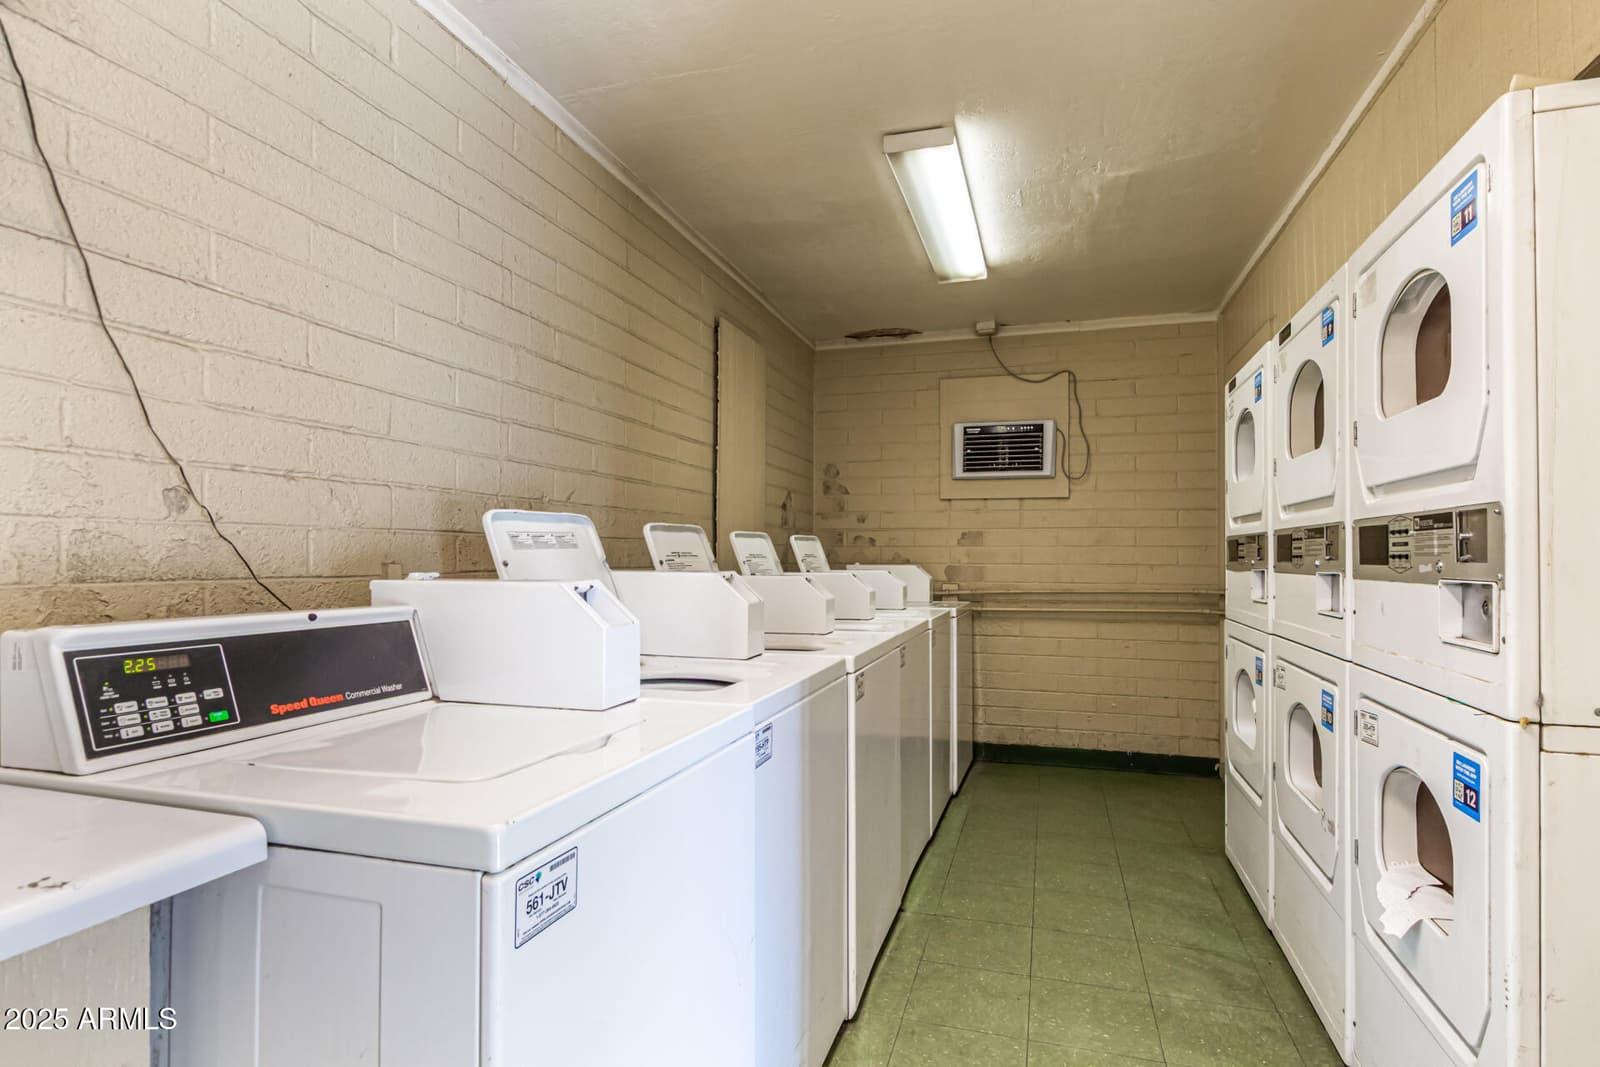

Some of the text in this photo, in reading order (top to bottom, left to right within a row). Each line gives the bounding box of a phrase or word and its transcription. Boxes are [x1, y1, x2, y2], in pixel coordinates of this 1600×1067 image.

[123, 657, 156, 674] 2.25
[270, 683, 402, 715] Speed Queen Commercial Washer
[1466, 789, 1477, 808] 12
[518, 877, 535, 891] CSC
[526, 877, 568, 914] 561-JTV
